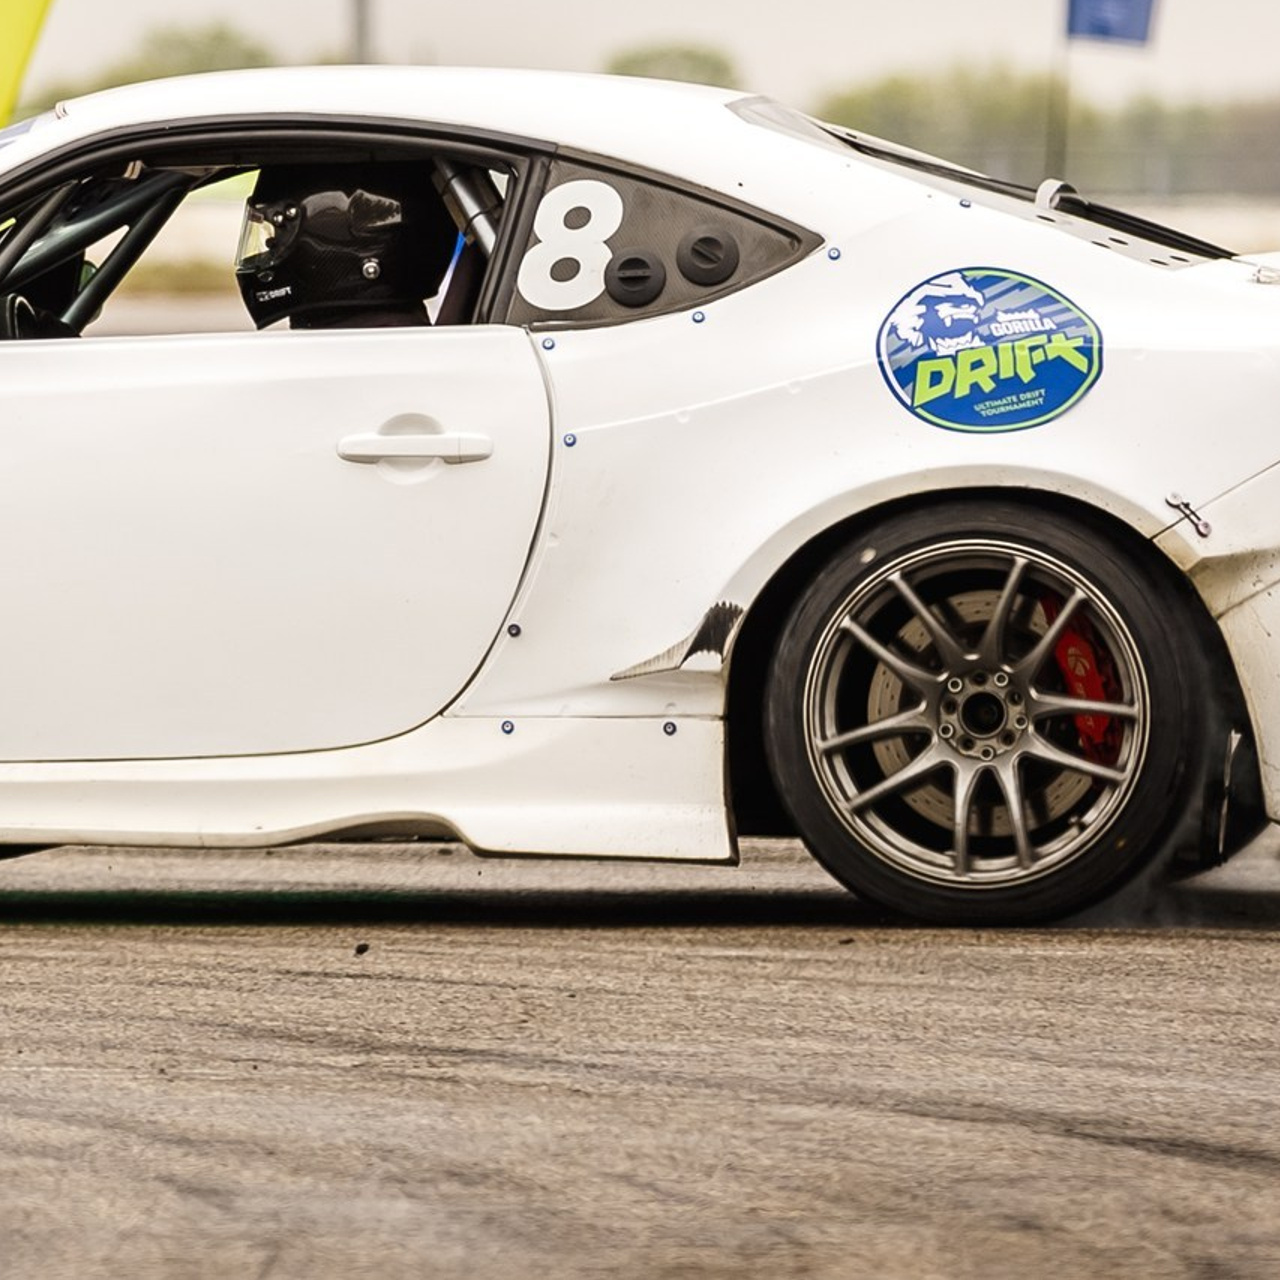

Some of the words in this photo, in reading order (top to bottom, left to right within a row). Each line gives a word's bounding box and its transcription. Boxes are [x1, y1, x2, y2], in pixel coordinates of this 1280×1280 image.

[517, 179, 624, 311] 8
[989, 317, 1057, 337] GORILLA
[973, 394, 1018, 412] ULTIMATE
[1019, 388, 1046, 402] DRIFT
[980, 397, 1045, 418] TOURNAMENT
